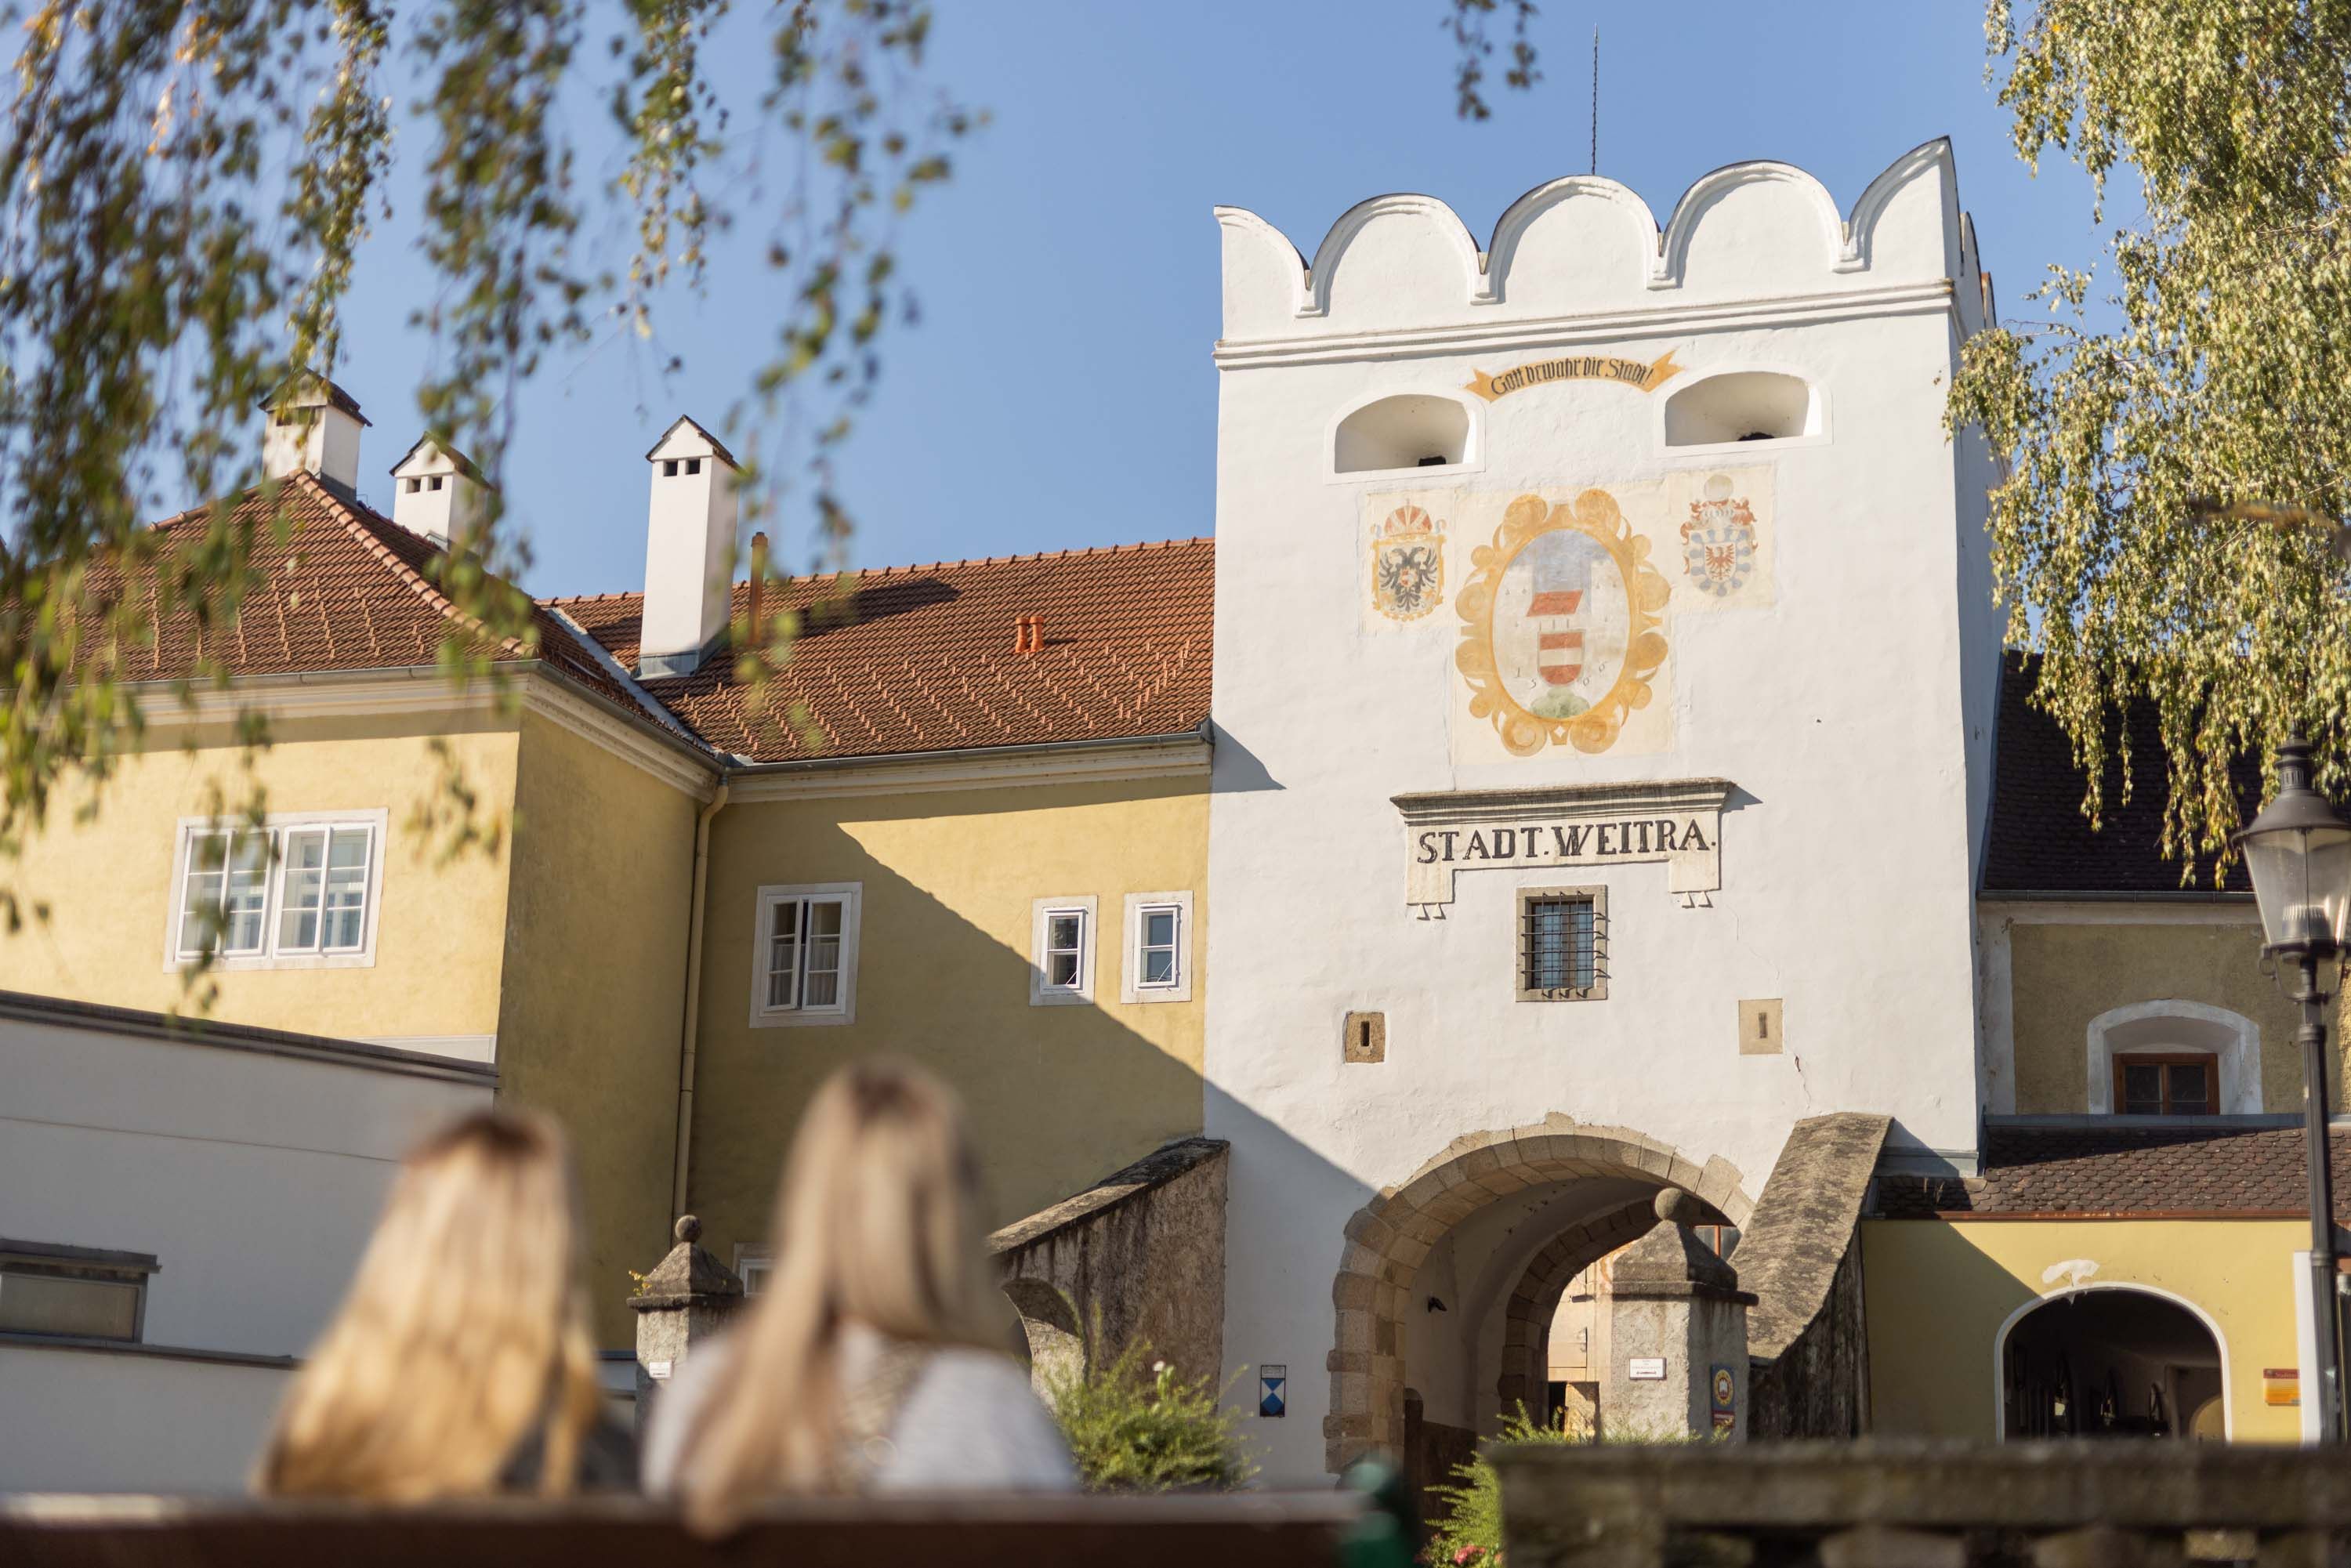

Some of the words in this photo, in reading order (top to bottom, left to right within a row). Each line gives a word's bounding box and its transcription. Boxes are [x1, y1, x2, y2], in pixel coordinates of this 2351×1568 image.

[1491, 368, 1524, 395] Gott
[1583, 357, 1605, 377] die
[1605, 358, 1654, 386] Stadt!
